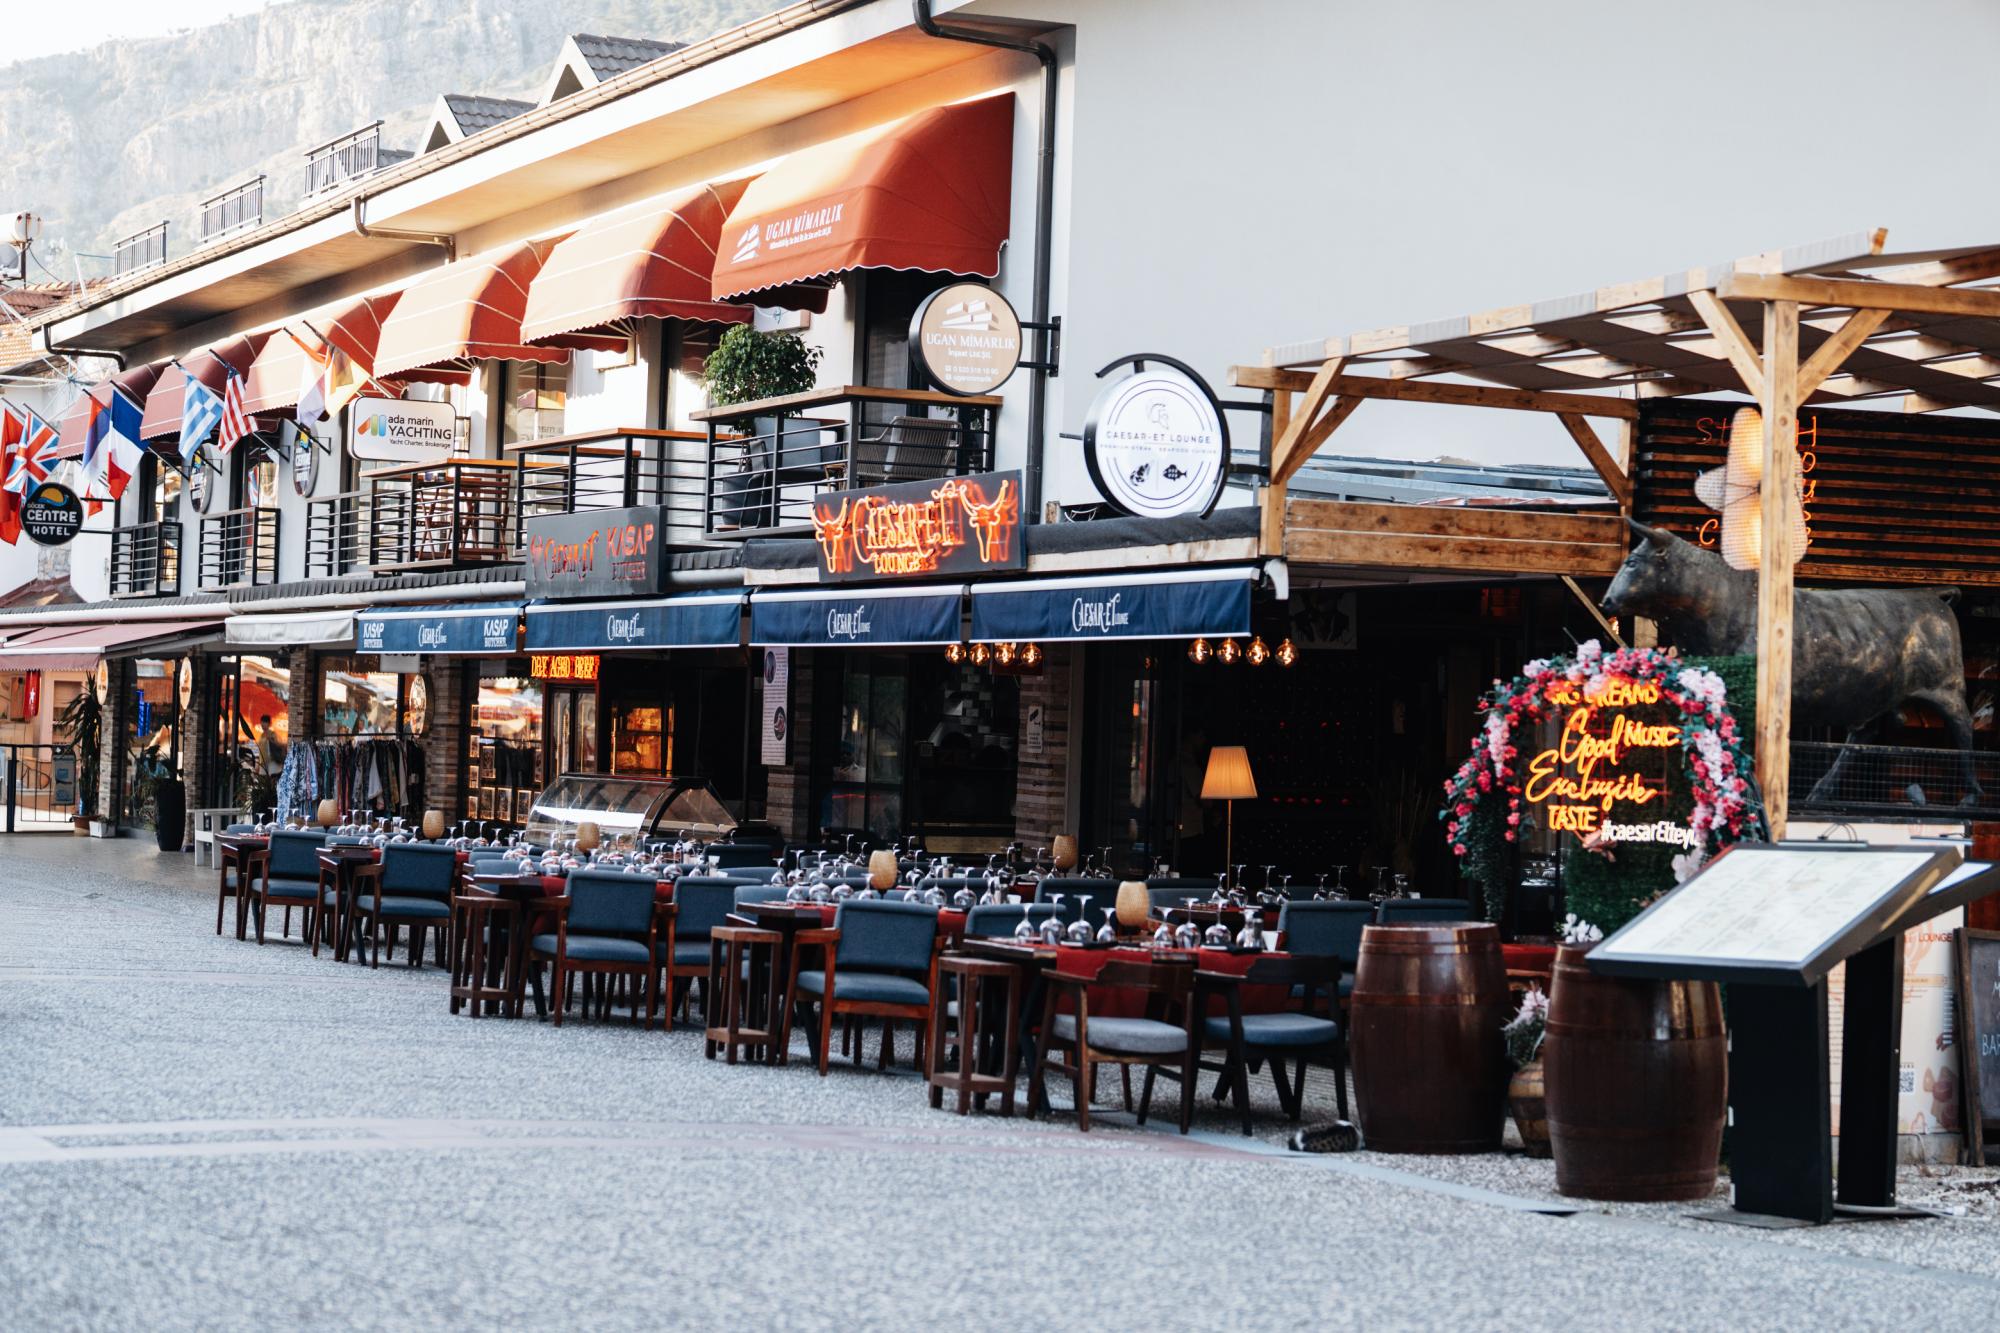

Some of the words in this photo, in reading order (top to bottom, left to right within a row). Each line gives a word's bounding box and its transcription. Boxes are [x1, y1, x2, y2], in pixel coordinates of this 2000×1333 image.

[765, 218, 792, 241] UGAN
[793, 203, 844, 234] MİMARLIK
[926, 333, 957, 346] UGAN
[960, 334, 1016, 350] MİMARLIK
[388, 414, 405, 425] ada
[407, 416, 434, 426] marin
[388, 425, 452, 440] YACHTING
[1106, 430, 1166, 441] CAESAR-ET
[1170, 433, 1211, 444] LOUNGE
[425, 441, 451, 449] Brokerage
[26, 509, 78, 523] CENTRE
[32, 525, 71, 536] HOTEL
[606, 522, 654, 559] KASAP
[363, 622, 385, 638] KASAP
[483, 619, 509, 636] KASAP
[1560, 708, 1625, 774] Good
[1548, 804, 1598, 832] TASTE
[1918, 932, 1953, 943] LOUNGE
